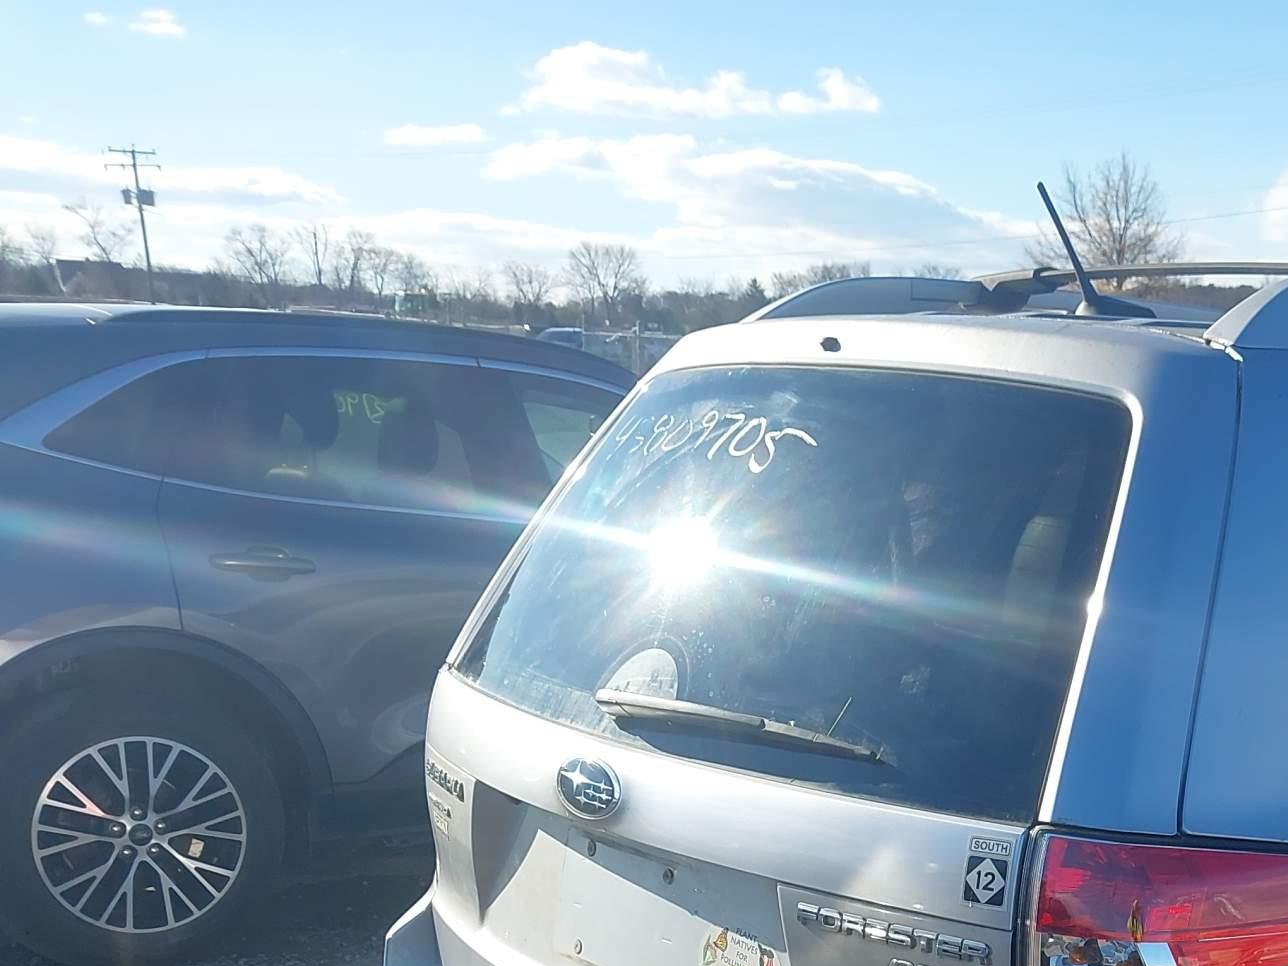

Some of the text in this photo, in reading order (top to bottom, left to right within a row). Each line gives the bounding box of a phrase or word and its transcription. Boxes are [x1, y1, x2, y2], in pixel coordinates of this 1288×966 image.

[972, 840, 1009, 854] SOUTH
[976, 869, 997, 892] 12
[736, 927, 758, 942] PLANT
[797, 901, 992, 966] FORESTER
[730, 935, 759, 956] NATIVES
[735, 950, 748, 963] FOR
